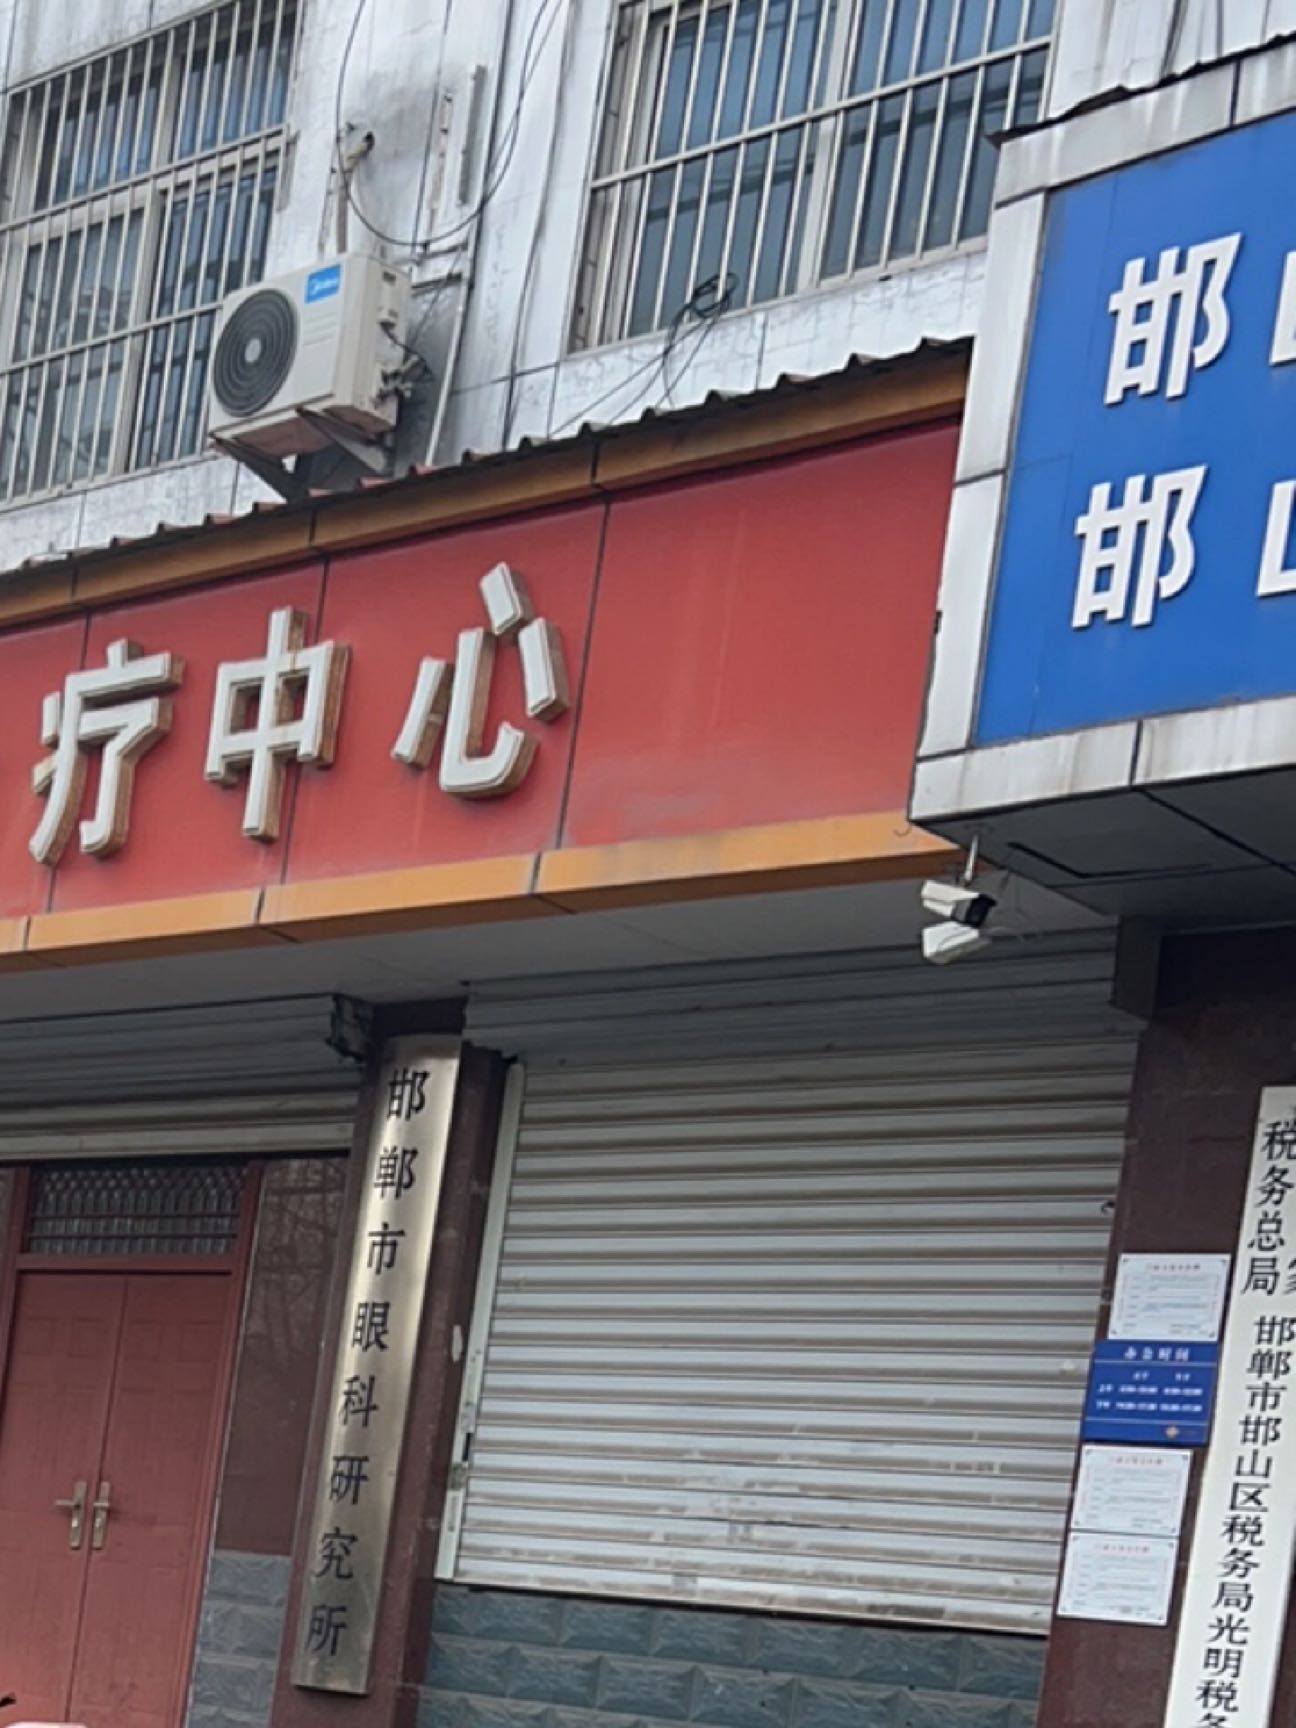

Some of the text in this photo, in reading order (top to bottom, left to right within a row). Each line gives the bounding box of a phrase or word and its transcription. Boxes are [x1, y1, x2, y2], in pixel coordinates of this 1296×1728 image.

[1104, 231, 1296, 406] 邯
[1071, 464, 1296, 630] 邯
[306, 1067, 431, 1656] 邯郸市眼科研究所
